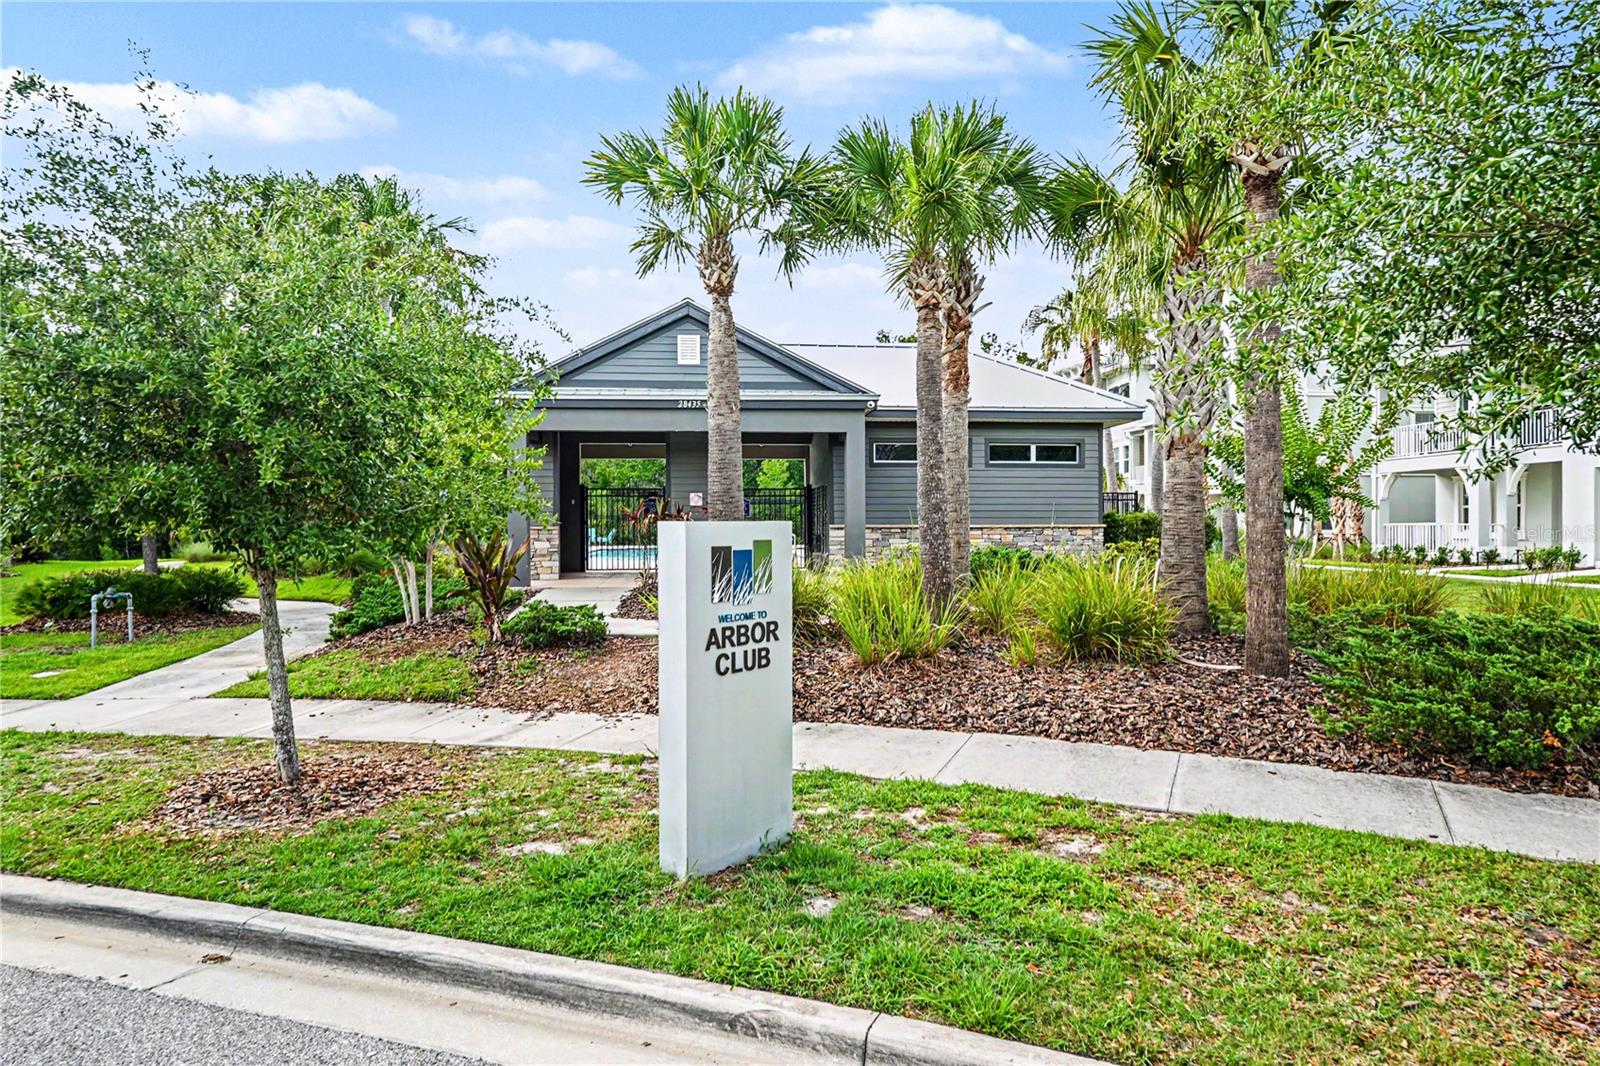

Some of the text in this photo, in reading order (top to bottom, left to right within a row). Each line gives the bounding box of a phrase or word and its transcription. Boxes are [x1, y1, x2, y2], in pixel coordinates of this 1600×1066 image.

[677, 400, 701, 408] 28435
[718, 610, 767, 623] WELCOME TO
[705, 620, 779, 651] ARBOR
[715, 647, 771, 676] CLUB
